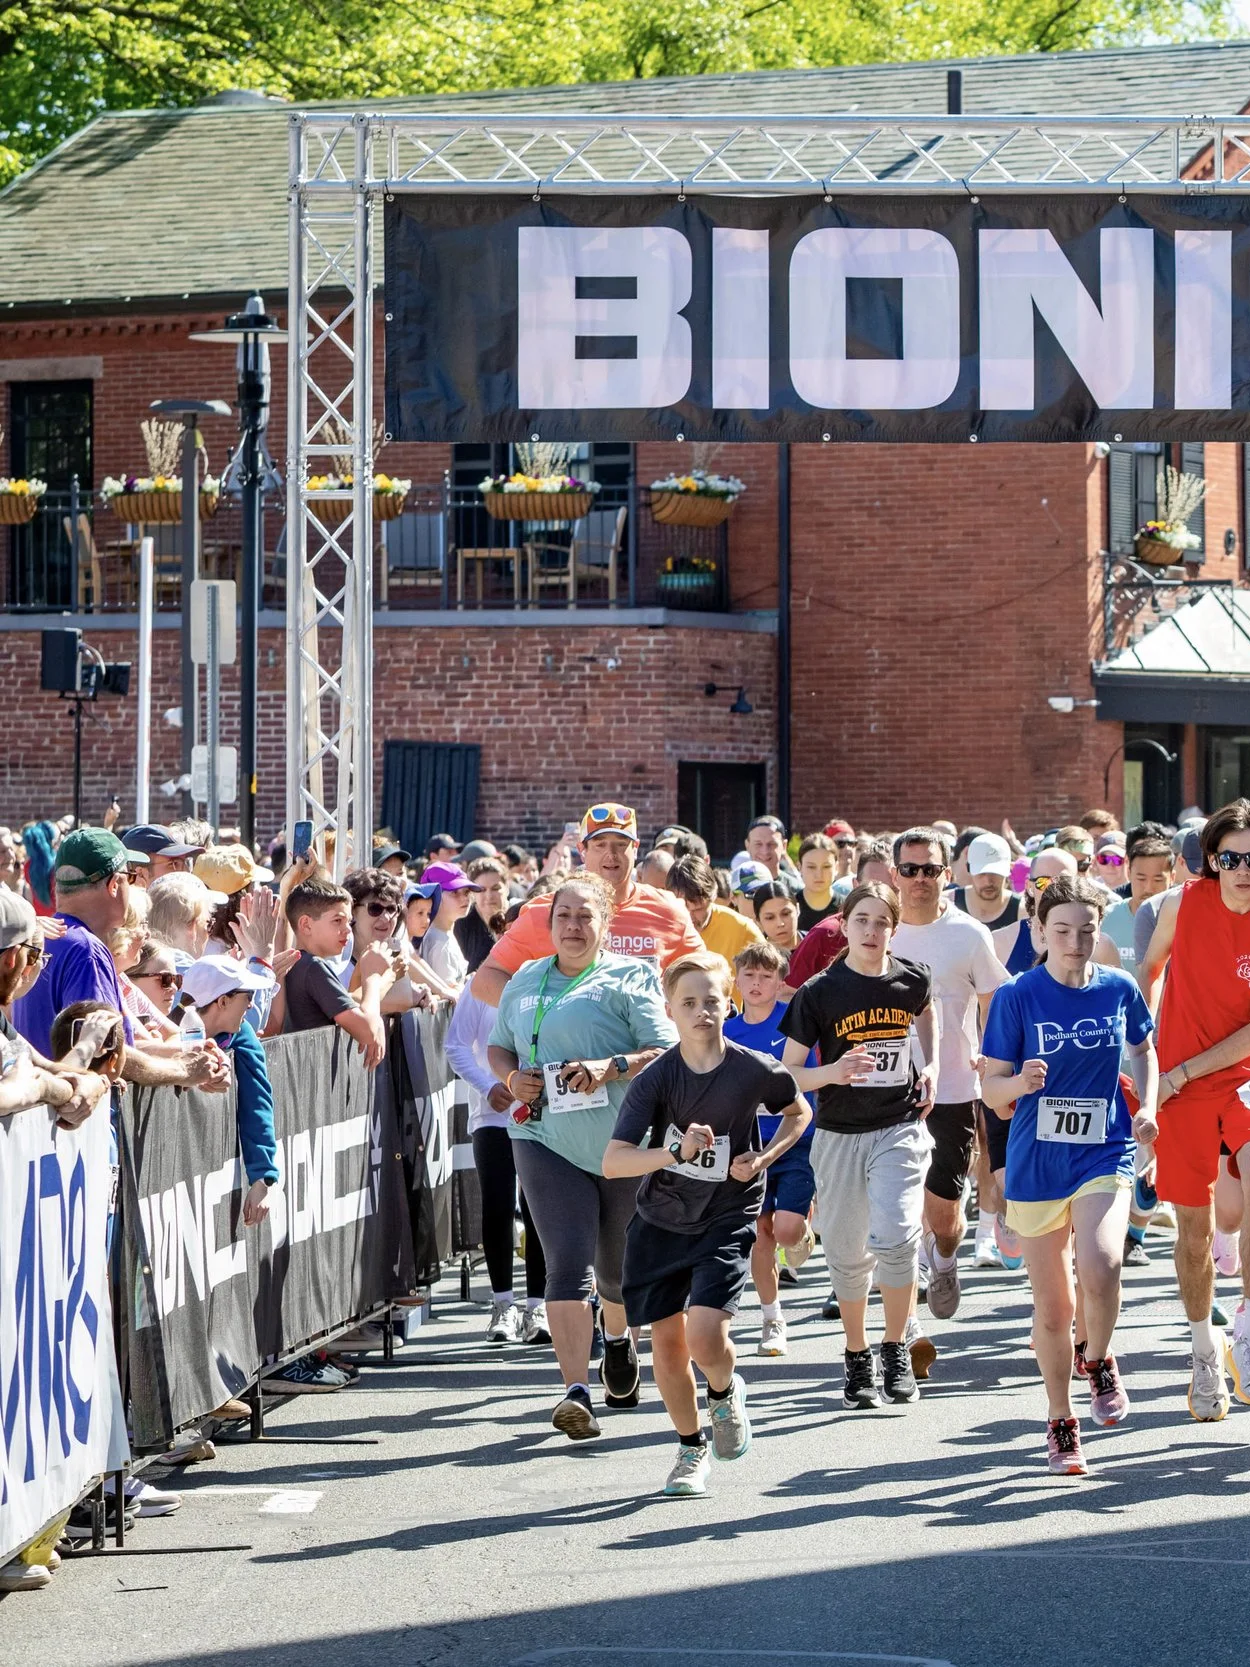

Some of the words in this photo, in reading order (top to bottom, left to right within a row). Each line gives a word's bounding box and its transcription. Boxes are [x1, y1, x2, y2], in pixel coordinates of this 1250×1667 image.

[835, 1011, 866, 1038] LATIN
[868, 1008, 914, 1027] ACADEM
[1044, 1030, 1078, 1042] Dedham
[1079, 1027, 1112, 1038] Country
[1045, 1098, 1092, 1108] BIONIC
[1053, 1110, 1092, 1136] 707
[687, 1150, 717, 1169] 26
